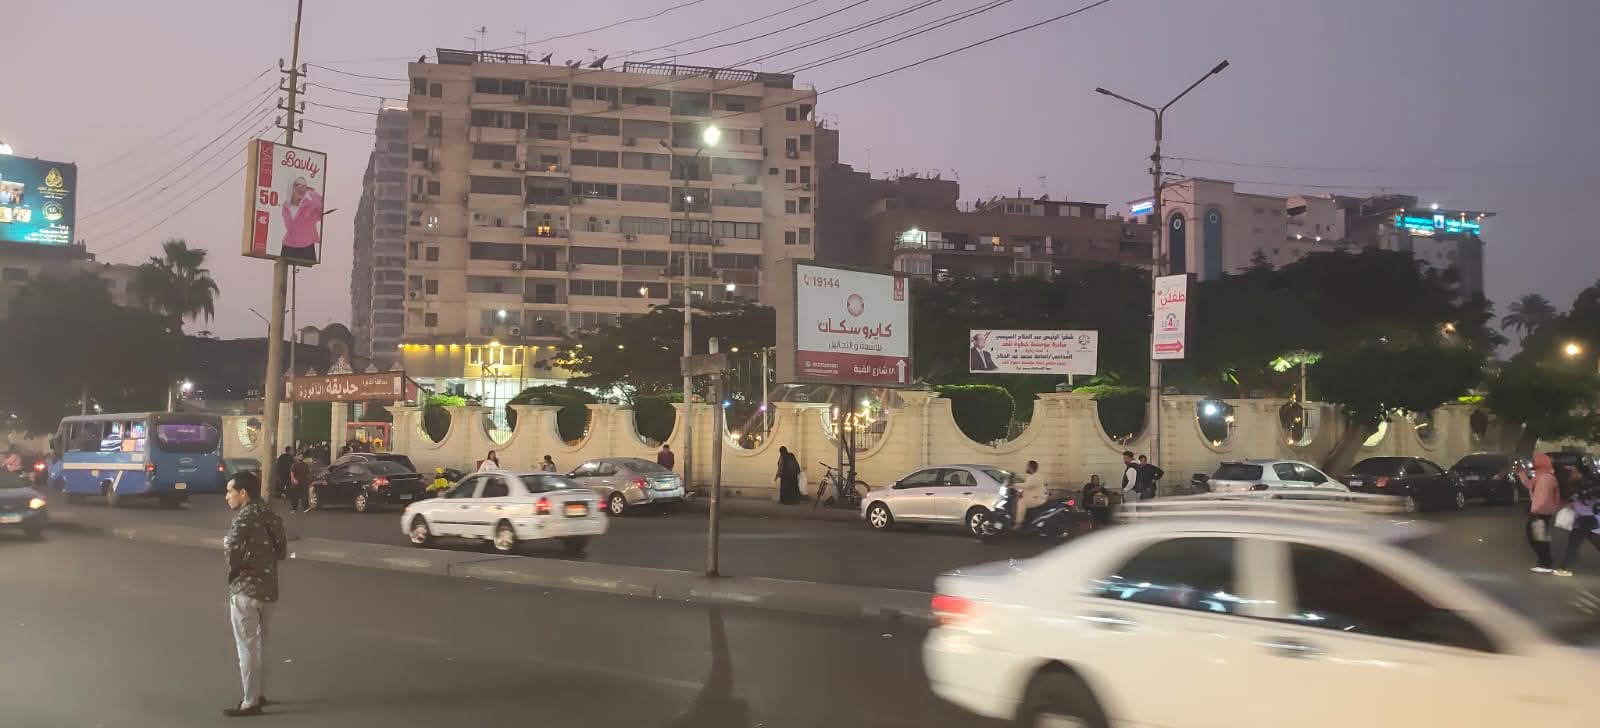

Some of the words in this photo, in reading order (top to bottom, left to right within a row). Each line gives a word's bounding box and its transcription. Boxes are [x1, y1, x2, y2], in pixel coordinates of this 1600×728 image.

[813, 277, 840, 288] 19144
[818, 318, 861, 335] سكان
[862, 322, 892, 340] كايرو
[872, 367, 888, 377] شارع
[326, 378, 359, 399] حديقة
